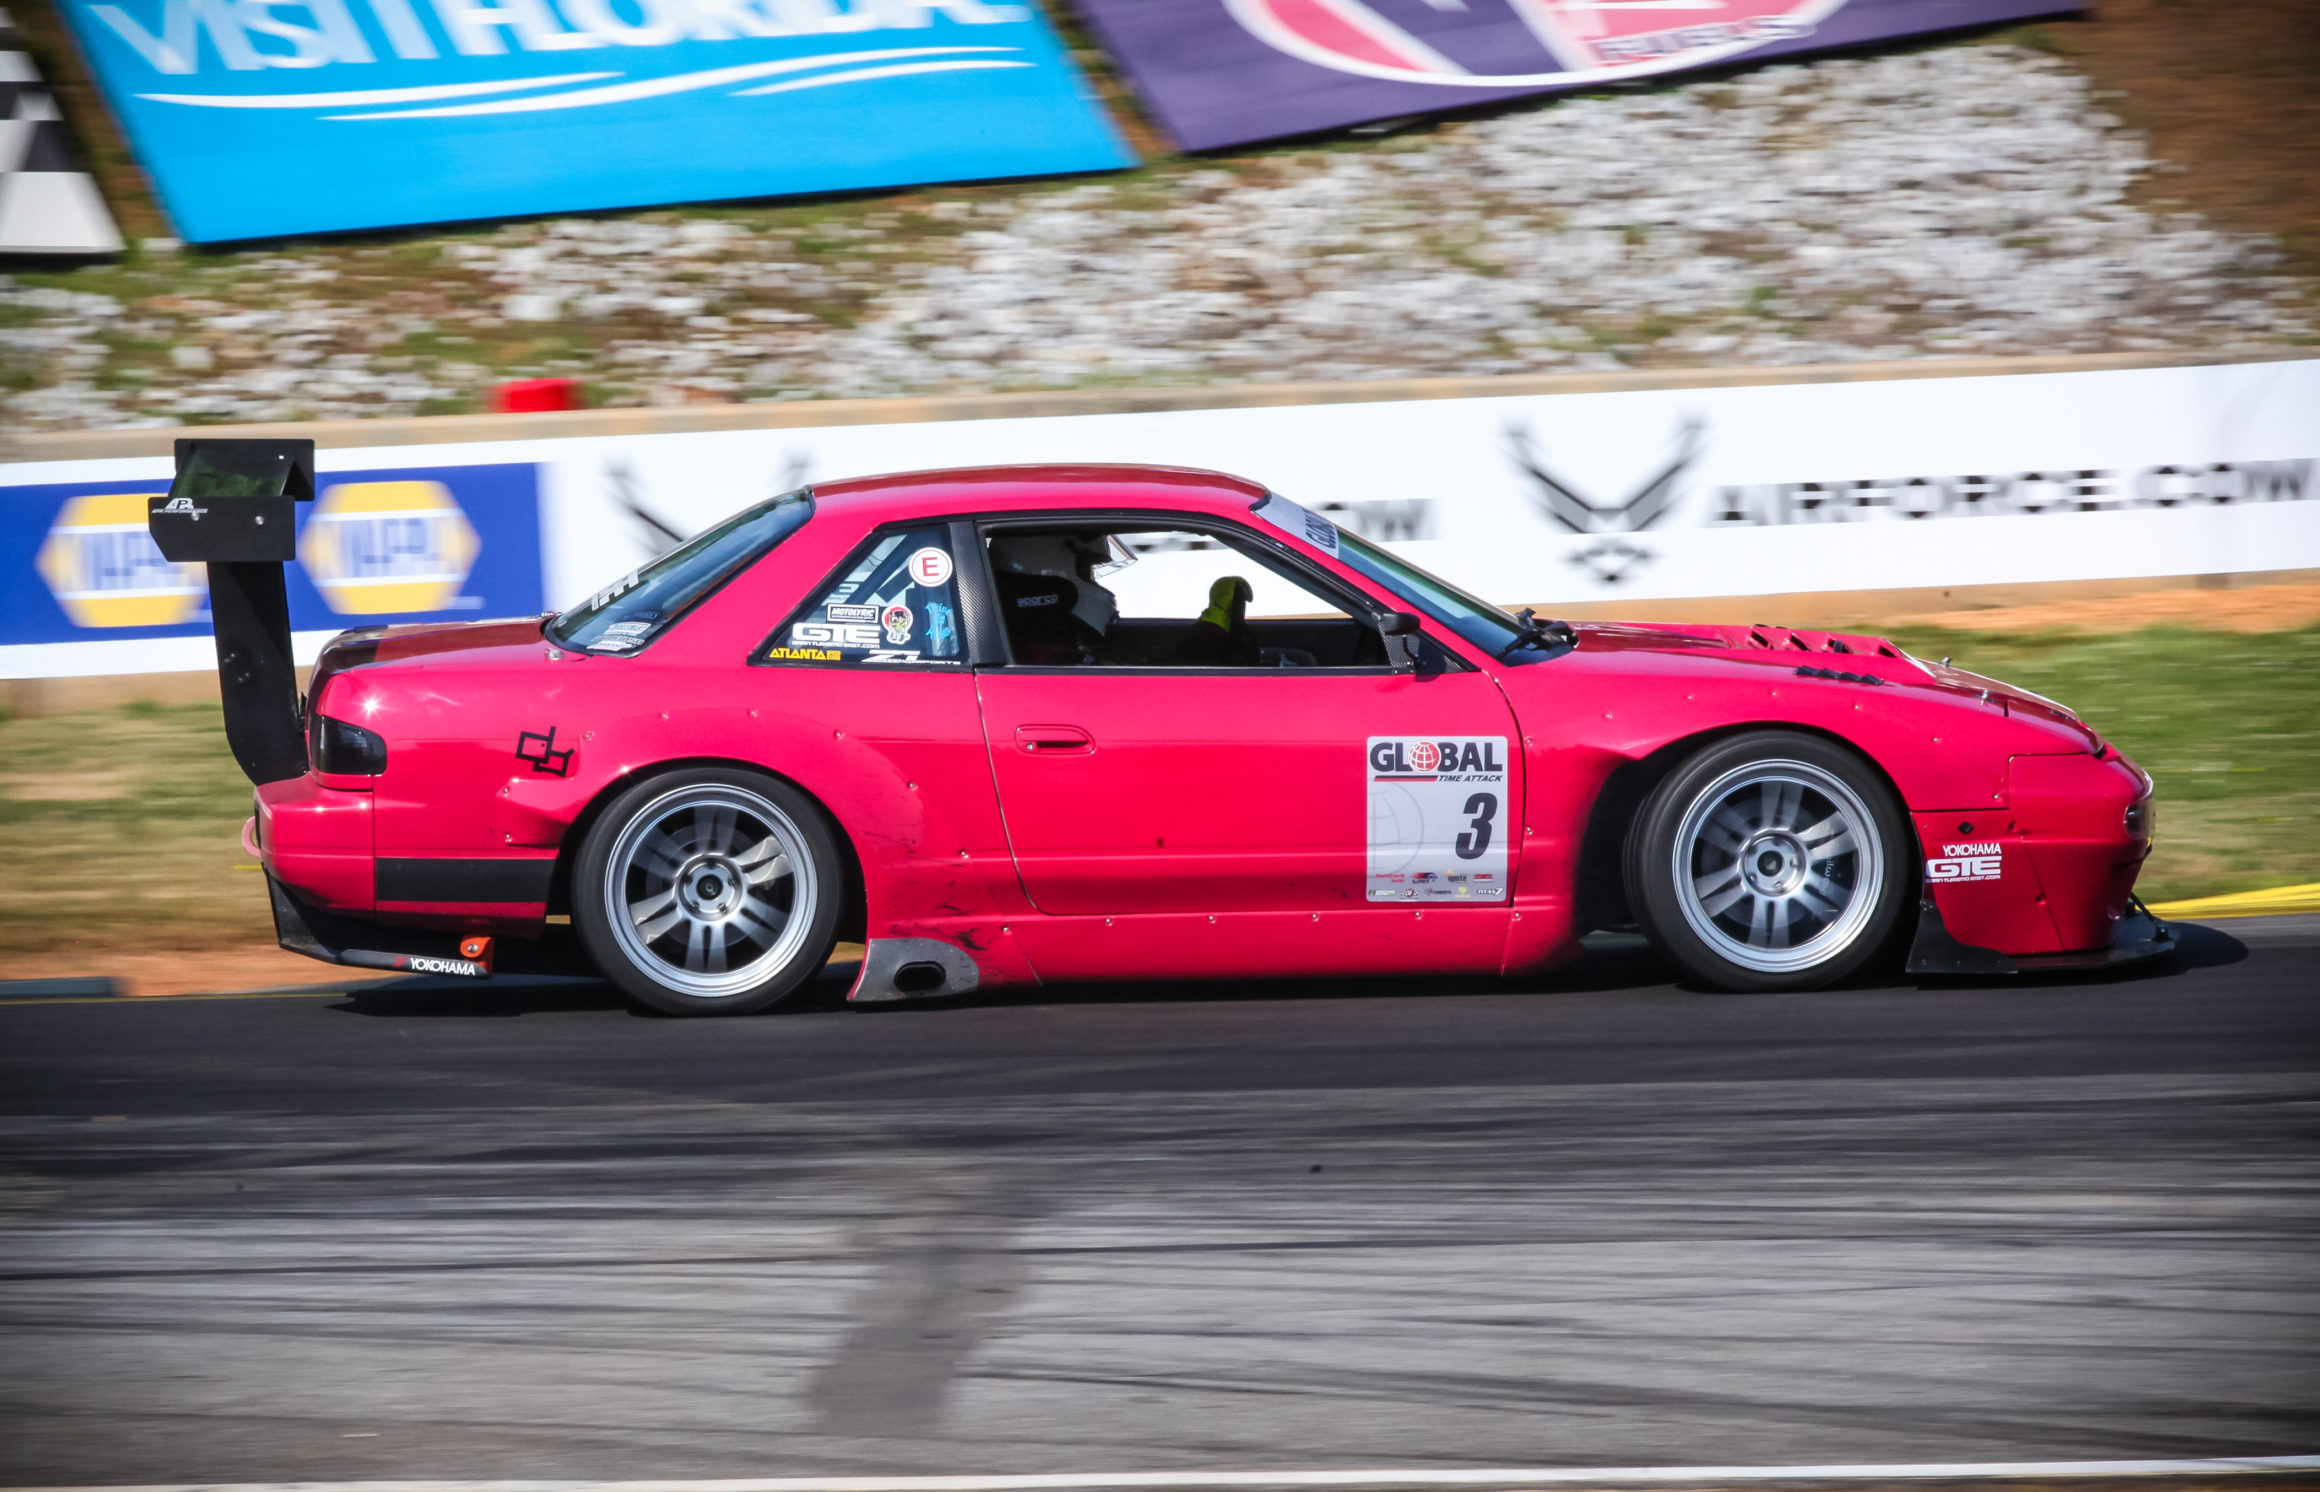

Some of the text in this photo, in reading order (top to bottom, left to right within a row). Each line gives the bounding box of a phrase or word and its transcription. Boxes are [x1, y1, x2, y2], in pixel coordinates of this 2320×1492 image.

[921, 556, 940, 577] E
[831, 607, 875, 617] MOTOLYRIC
[792, 622, 881, 644] GTE
[769, 647, 826, 660] ATLANTA
[1369, 741, 1503, 772] GLOBAL
[1455, 792, 1498, 860] 3
[1942, 843, 2002, 857] YOKOHAMA
[1925, 856, 2002, 878] GTE
[410, 957, 476, 976] YOKOHAMA
